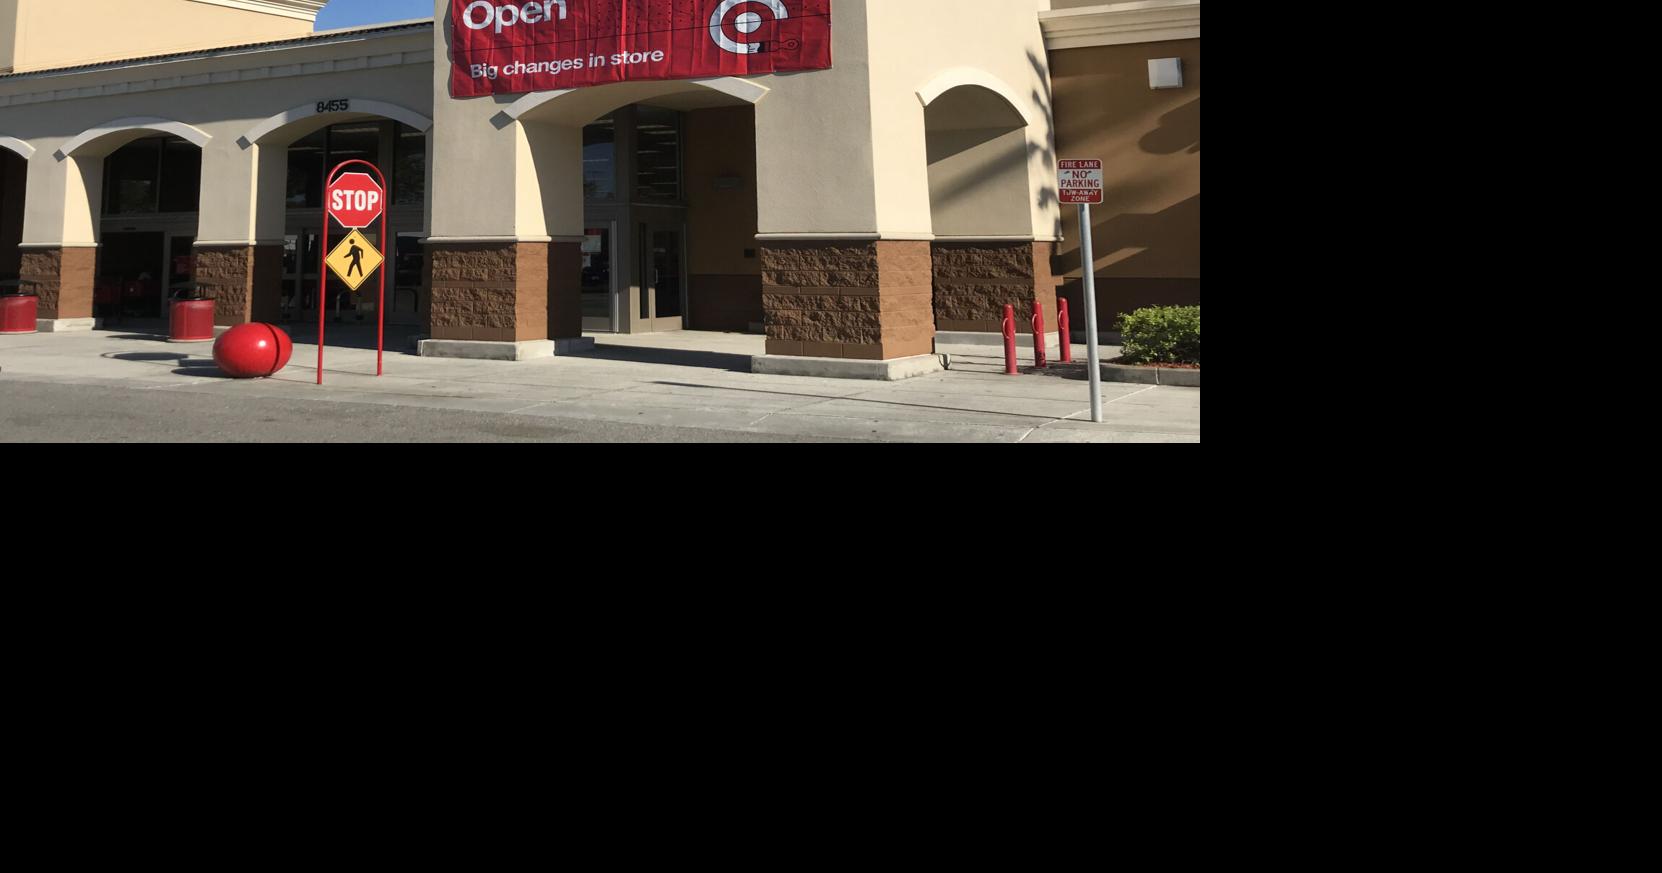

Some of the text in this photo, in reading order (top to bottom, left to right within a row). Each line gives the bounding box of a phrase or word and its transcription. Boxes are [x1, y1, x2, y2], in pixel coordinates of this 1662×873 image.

[463, 0, 567, 33] Open
[470, 50, 665, 79] Big changes in store
[316, 99, 349, 113] 8455
[1061, 179, 1099, 187] PARKING
[1072, 170, 1088, 178] NO
[332, 189, 379, 211] STOP
